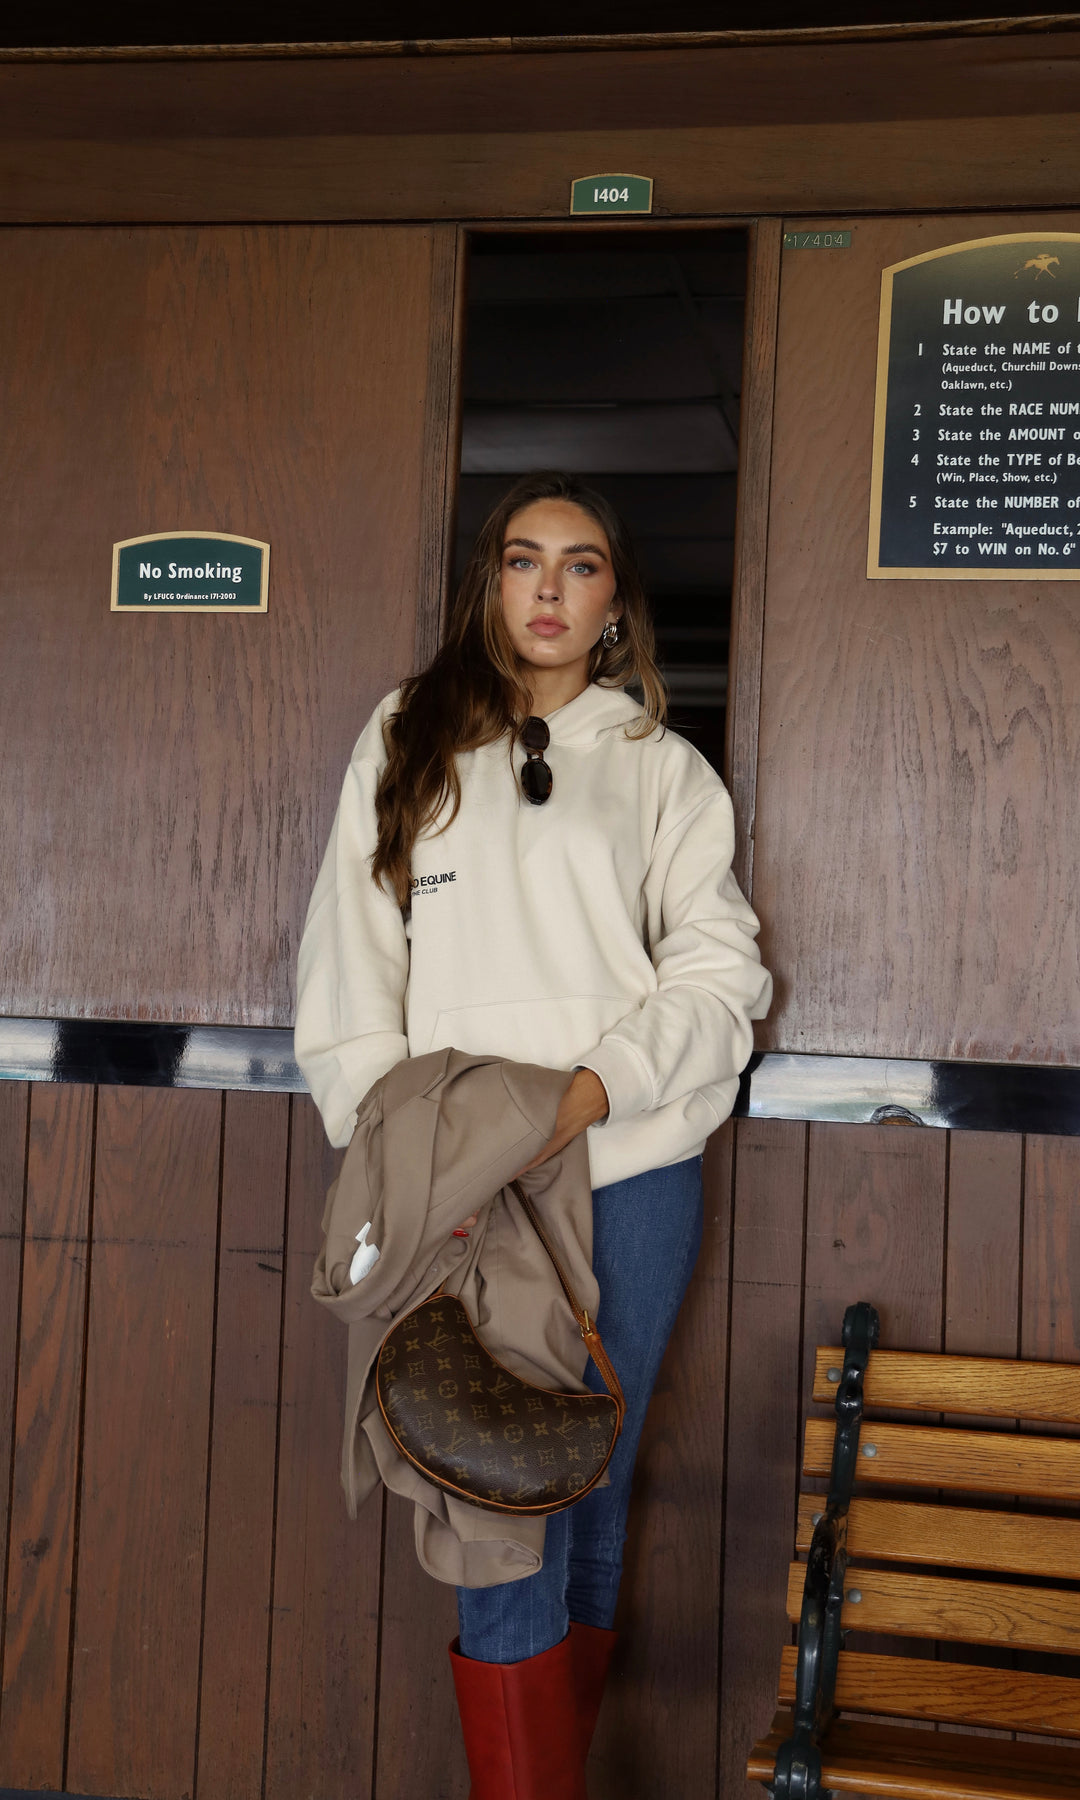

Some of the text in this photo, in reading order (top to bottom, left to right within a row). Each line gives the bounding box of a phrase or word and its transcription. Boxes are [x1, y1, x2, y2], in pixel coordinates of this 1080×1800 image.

[594, 188, 629, 203] 1404
[943, 299, 1006, 324] How
[1027, 300, 1059, 323] to
[918, 343, 923, 356] 1
[942, 343, 977, 356] State
[984, 342, 1006, 355] the
[1012, 342, 1051, 355] NAME
[1057, 341, 1072, 354] of
[942, 362, 997, 375] (Aqueduct,
[1001, 361, 1046, 372] Churchill
[941, 379, 1013, 391] Oaklawn, etc.)
[914, 402, 1080, 417] 2 State the RACE NUM
[912, 429, 920, 441] 3
[938, 429, 973, 442] State
[979, 429, 1002, 441] the
[1008, 428, 1066, 441] AMOUNT
[911, 454, 919, 466] 4
[937, 453, 971, 466] State
[978, 454, 1000, 466] the
[1007, 453, 1042, 466] TYPE
[1048, 453, 1063, 466] of
[936, 472, 1057, 485] (Win, Place, Show, etc.)
[909, 496, 1080, 509] 5 State the NUMBER of
[933, 522, 993, 538] Example:
[1002, 522, 1074, 538] "Aqueduct,
[933, 541, 948, 556] $7
[955, 543, 970, 555] to
[978, 542, 1008, 555] WIN
[1014, 546, 1032, 555] on
[139, 562, 243, 583] No Smoking
[143, 593, 153, 602] By
[420, 871, 456, 886] EQUINE
